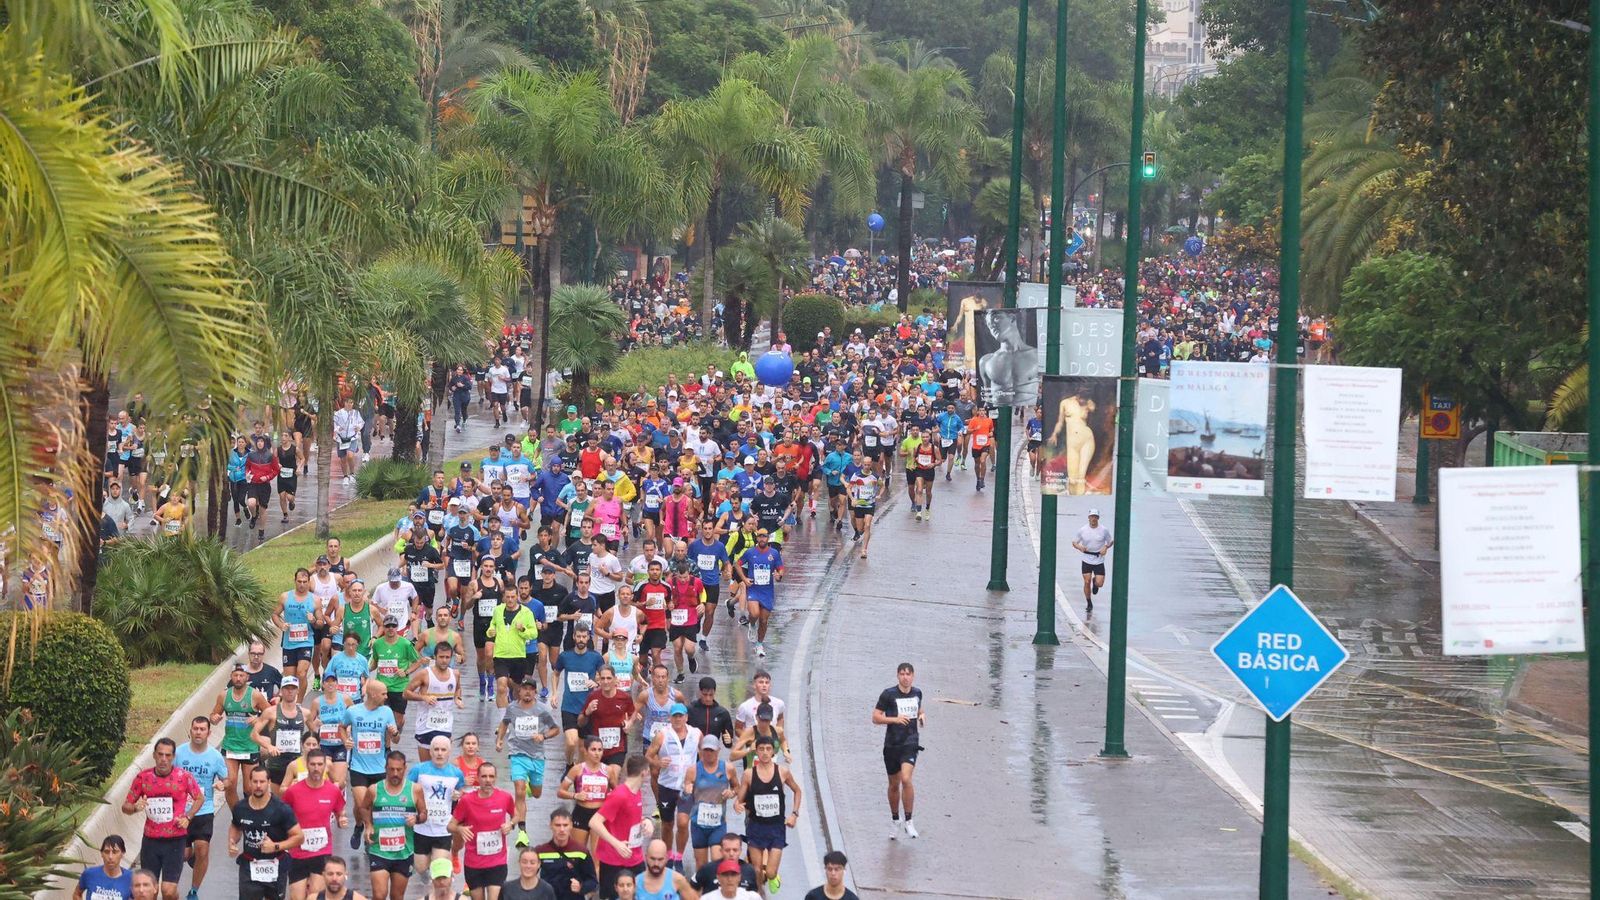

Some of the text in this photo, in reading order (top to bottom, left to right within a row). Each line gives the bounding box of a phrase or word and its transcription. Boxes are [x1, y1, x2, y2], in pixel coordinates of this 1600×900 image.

[1071, 322, 1115, 337] DES
[1078, 343, 1108, 357] NU
[1070, 361, 1116, 376] DOS
[1257, 632, 1302, 651] RED
[1238, 650, 1320, 672] BÁSICA
[356, 720, 382, 729] nerja
[148, 806, 171, 815] 11322
[306, 837, 324, 845] 1277
[385, 837, 400, 845] 112
[255, 866, 274, 874] 5065
